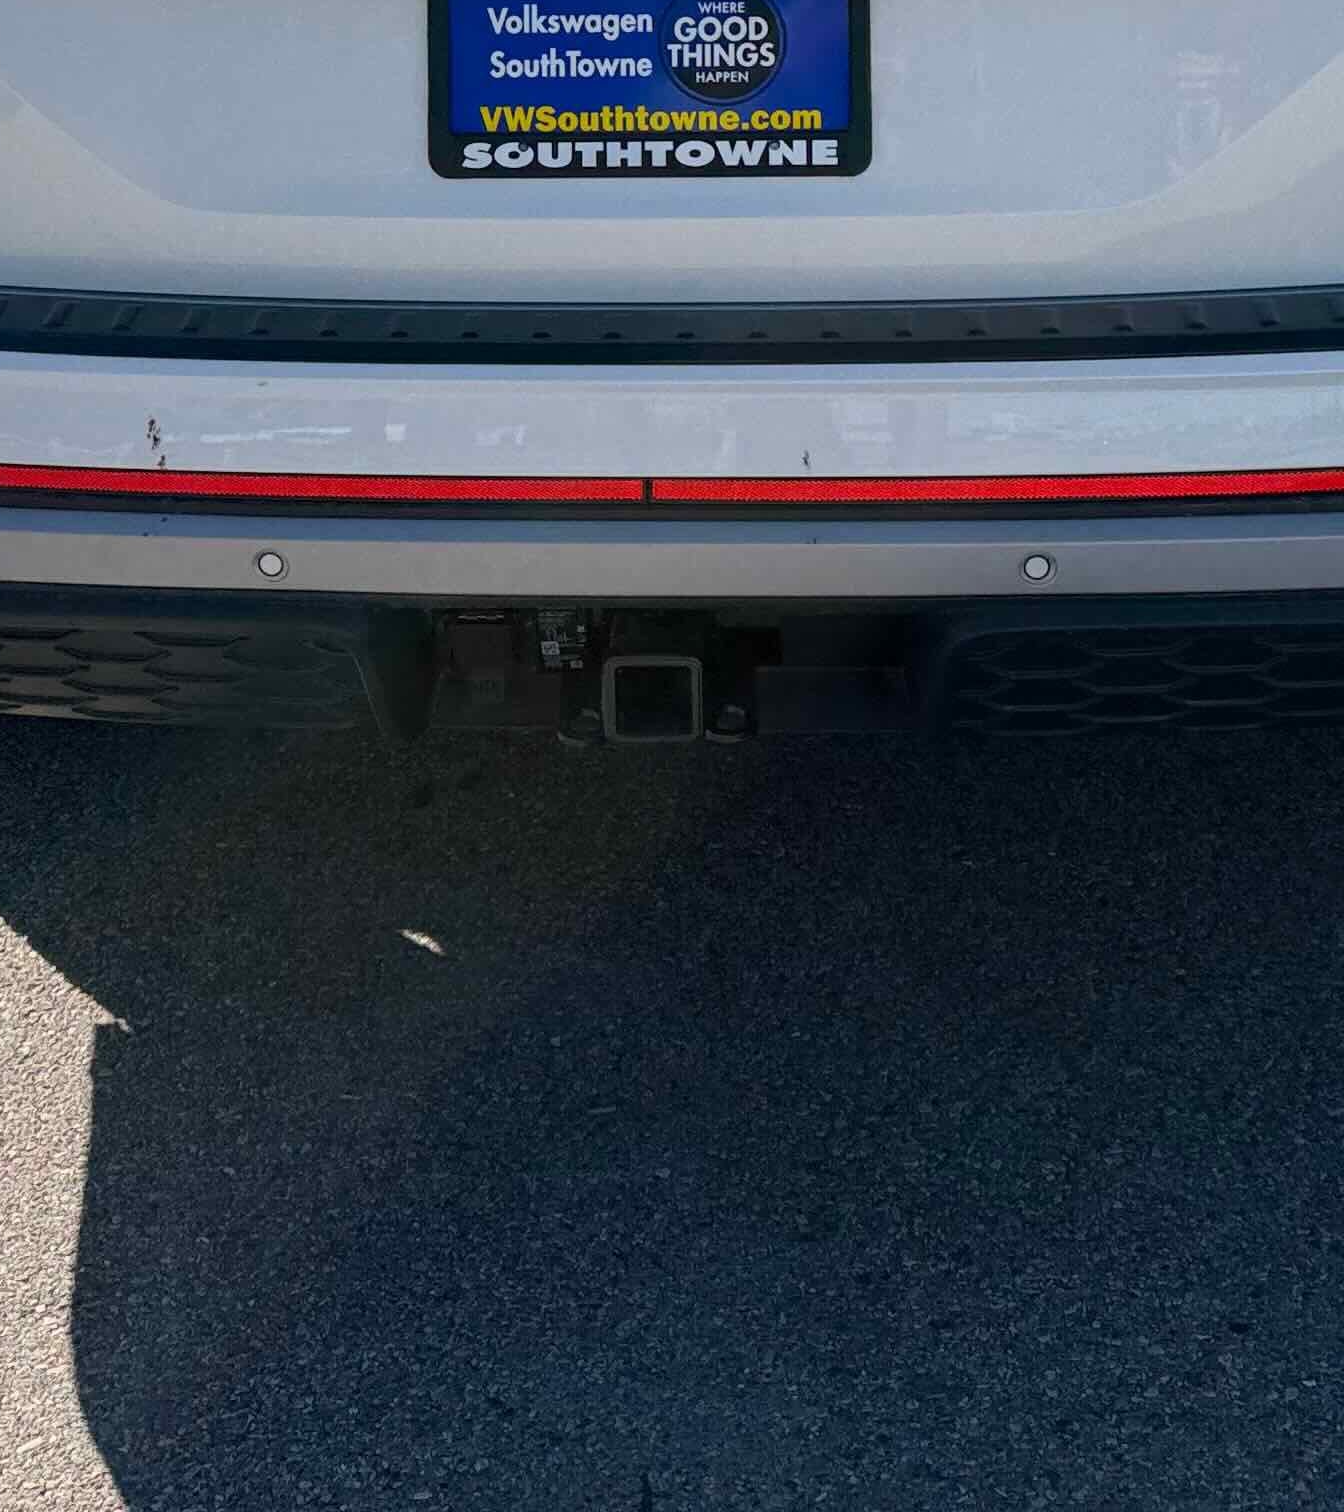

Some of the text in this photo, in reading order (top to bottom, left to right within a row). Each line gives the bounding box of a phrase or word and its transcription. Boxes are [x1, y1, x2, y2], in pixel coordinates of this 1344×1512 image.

[698, 1, 745, 14] WHERE
[487, 4, 654, 41] Volkswagen
[673, 16, 769, 43] GOOD
[667, 43, 776, 68] THINGS
[695, 71, 749, 84] HAPPEN
[480, 106, 823, 133] VWSouthtowne.com
[461, 139, 839, 169] SOUTHTOWNE
